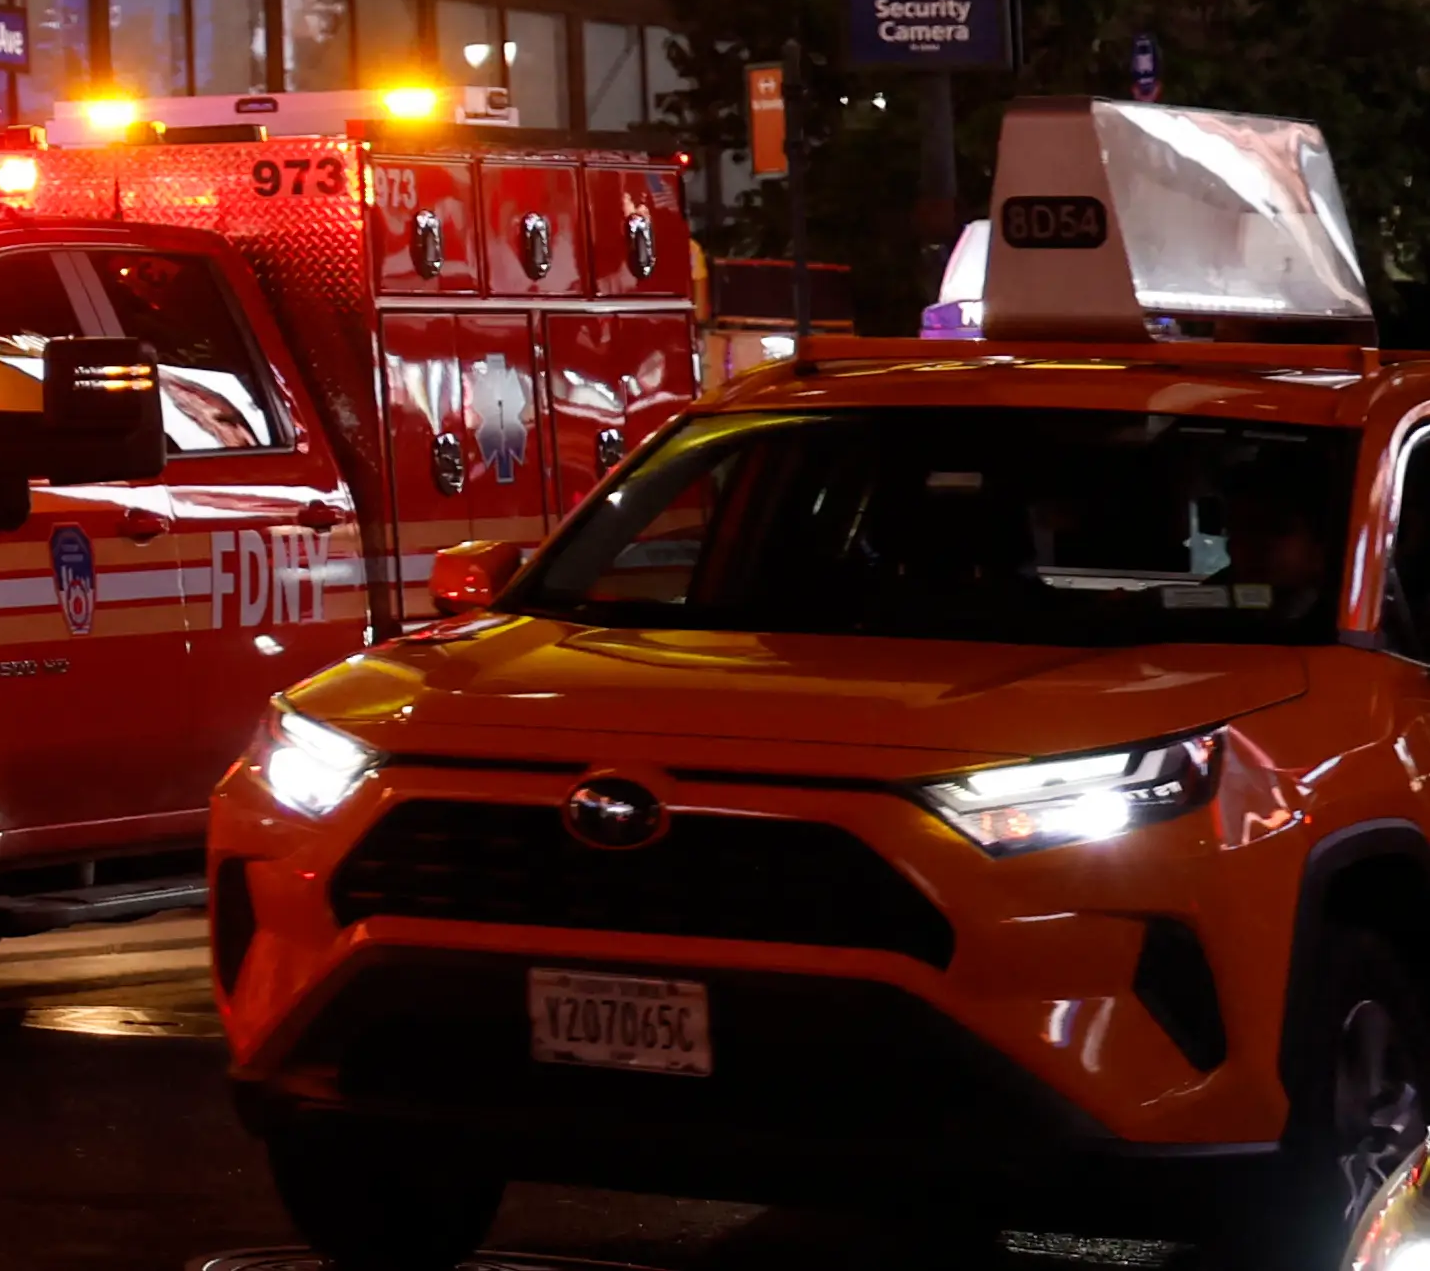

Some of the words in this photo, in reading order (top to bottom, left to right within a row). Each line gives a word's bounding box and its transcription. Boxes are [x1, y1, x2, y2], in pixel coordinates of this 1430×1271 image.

[878, 20, 970, 42] Camera
[252, 159, 345, 197] 973
[375, 166, 416, 208] 973
[212, 528, 331, 629] FDNY
